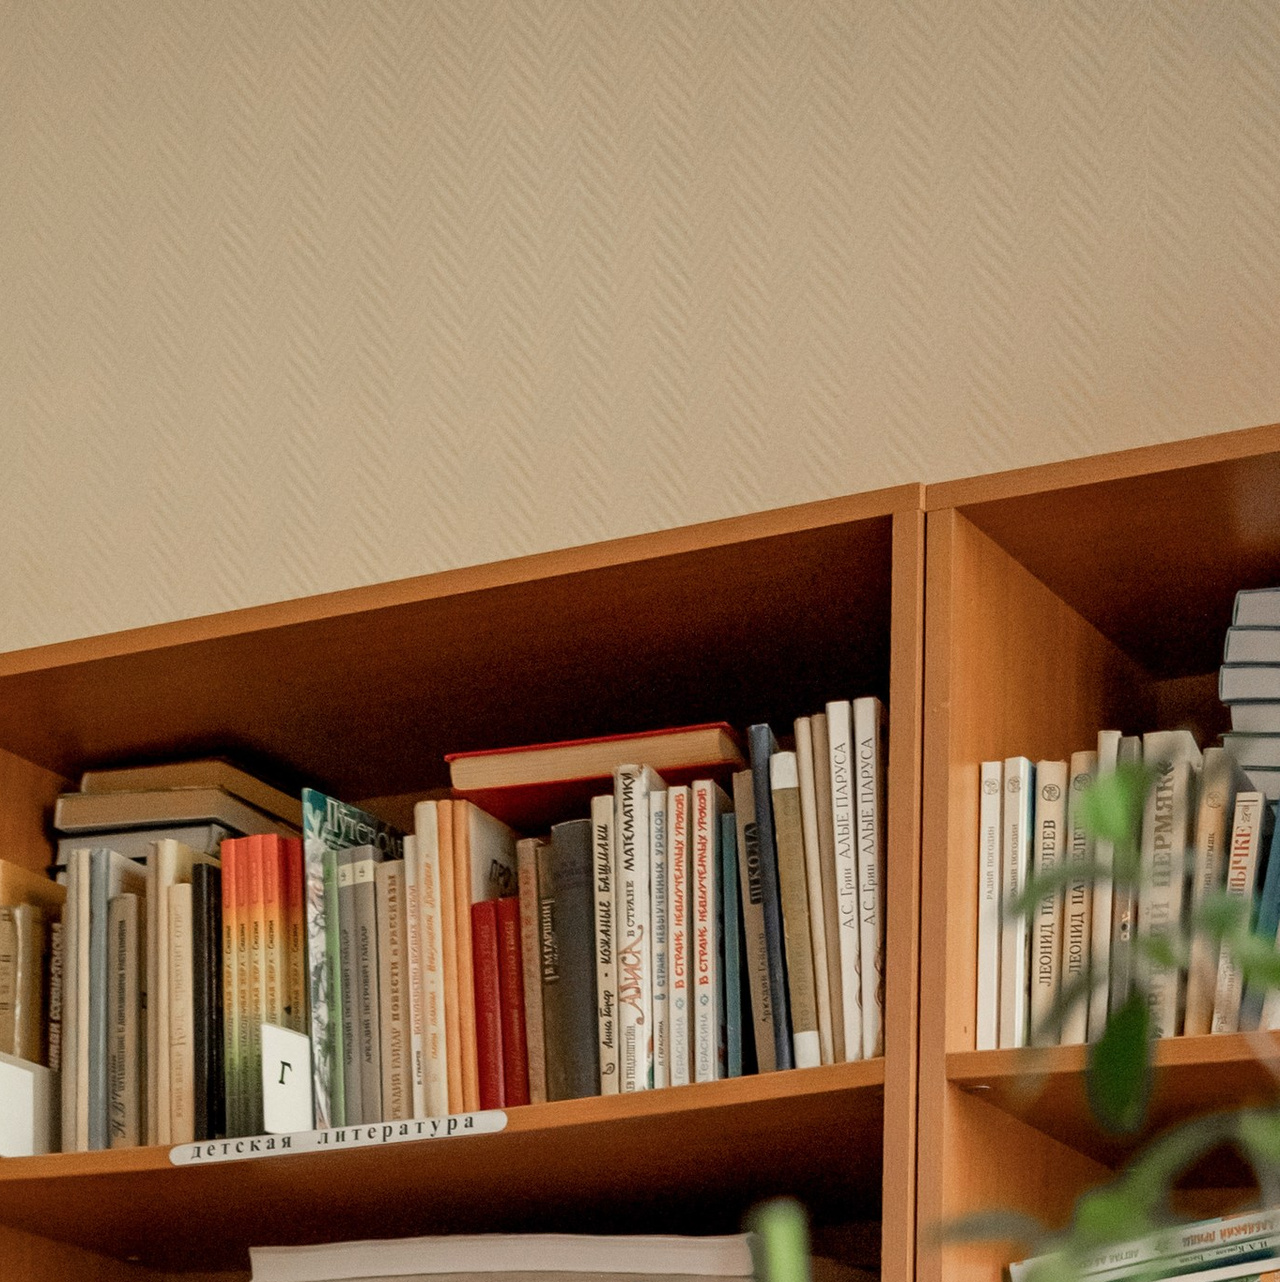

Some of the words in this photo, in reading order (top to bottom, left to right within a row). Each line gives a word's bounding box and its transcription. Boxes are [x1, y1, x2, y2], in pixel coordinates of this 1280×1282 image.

[832, 741, 848, 807] ПАРУСА
[859, 737, 873, 802] ПАРУСА
[620, 772, 634, 872] МАТЕМАТИКИ
[675, 792, 684, 834] УРОКОВ
[695, 788, 707, 831] УРОКОВ
[860, 808, 874, 855] АЛЫЕ
[653, 811, 663, 855] УРОКОВ
[836, 812, 850, 859] АЛЫЕ
[985, 825, 996, 866] ПОГОДИН
[1009, 823, 1020, 865] ПОГОДИН
[596, 824, 611, 892] БАШМАКИ
[695, 836, 707, 921] НЕВЫУЧЕННЫХ
[745, 828, 762, 900] ШКОЛА
[863, 862, 877, 892] Грин
[624, 880, 634, 926] СТРАНЕ
[654, 862, 664, 943] НЕВЫУЧЕННЫХ
[674, 839, 684, 925] НЕВЫУЧЕННЫХ
[839, 867, 855, 896] Грин
[984, 870, 994, 900] РАДИЙ
[387, 873, 398, 945] РАССКАЗЫ
[359, 925, 367, 960] ГАЙДАР
[599, 901, 612, 964] КОЖАНЫЕ
[626, 928, 635, 937] В
[674, 930, 684, 975] СТРАНЕ
[696, 927, 708, 971] СТРАНЕ
[1039, 922, 1054, 986] ЛЕОНИД
[1068, 911, 1084, 974] ЛЕОНИД
[362, 964, 370, 1013] ПЕТРОВИЧ
[389, 961, 400, 1021] ПОВЕСТИ
[616, 924, 644, 1025] АЛИСА
[655, 952, 665, 986] СТРАНЕ
[675, 979, 684, 988] В
[697, 976, 708, 984] В
[343, 967, 351, 1017] ПЕТРОВИЧ
[410, 968, 421, 1035] КОРОЛЕВСТВО
[344, 1021, 352, 1064] АРКАДИЙ
[363, 1018, 372, 1062] АРКАДИЙ
[390, 1026, 401, 1069] ГАЙДАР
[278, 1060, 292, 1084] Г
[190, 1135, 292, 1159] детская
[316, 1115, 475, 1148] литература
